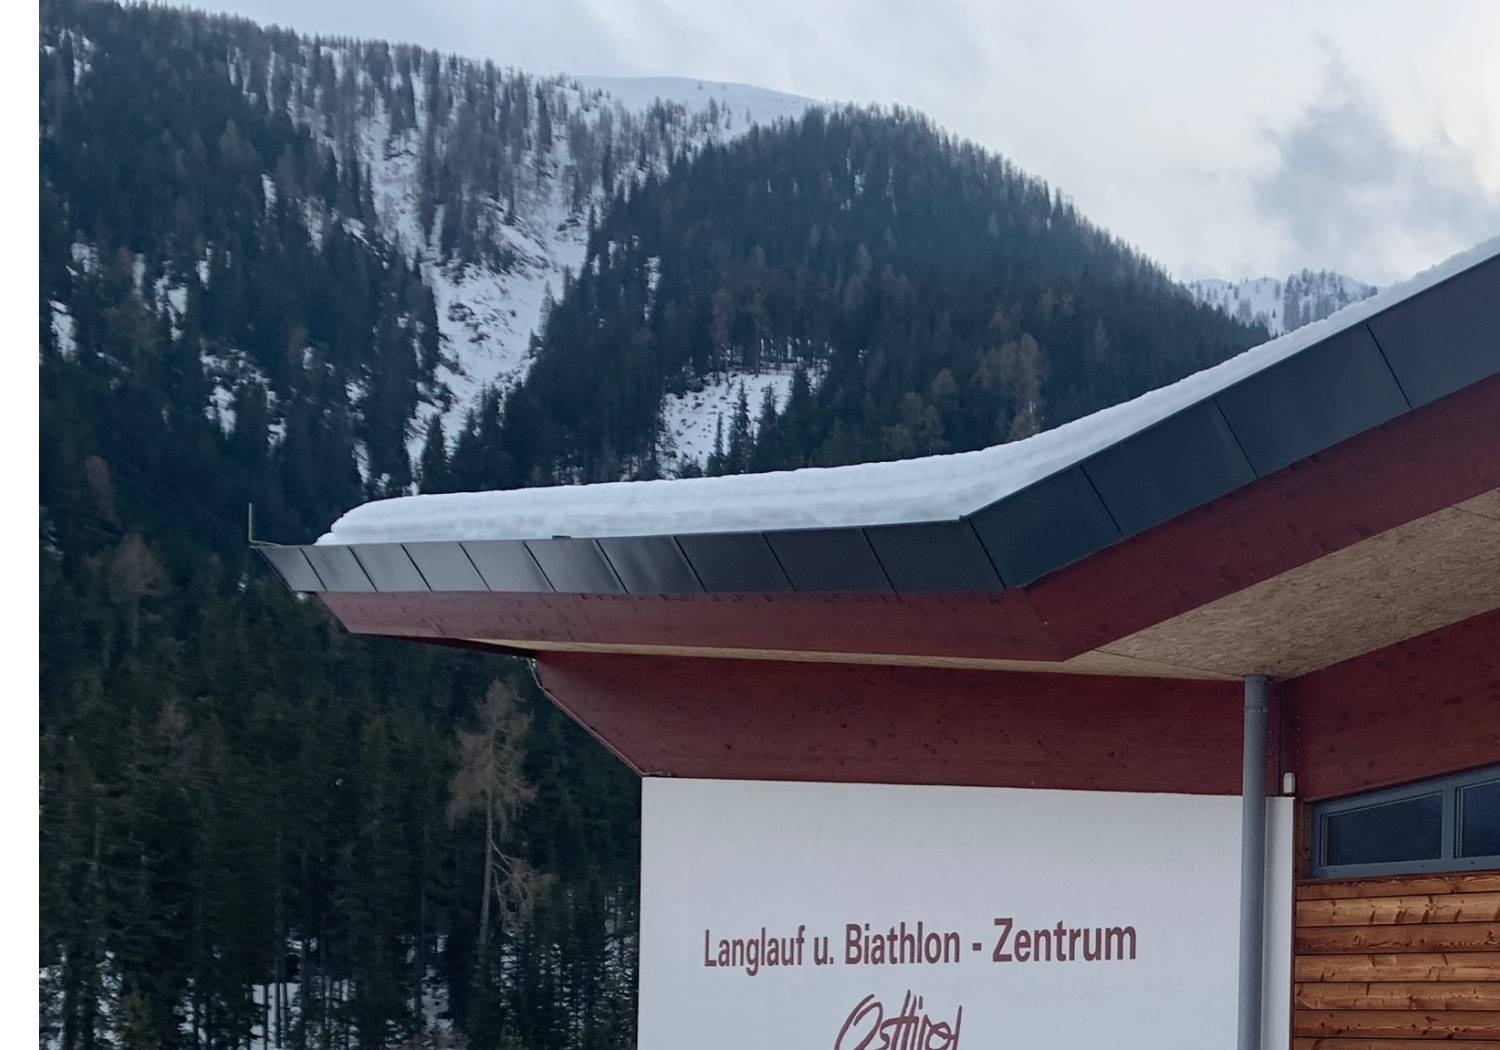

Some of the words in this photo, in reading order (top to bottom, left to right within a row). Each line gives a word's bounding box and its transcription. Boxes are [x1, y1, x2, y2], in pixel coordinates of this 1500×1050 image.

[704, 925, 805, 976] Langlauf
[813, 936, 834, 966] u.
[845, 921, 960, 965] Biathlon
[992, 917, 1137, 963] Zentrum
